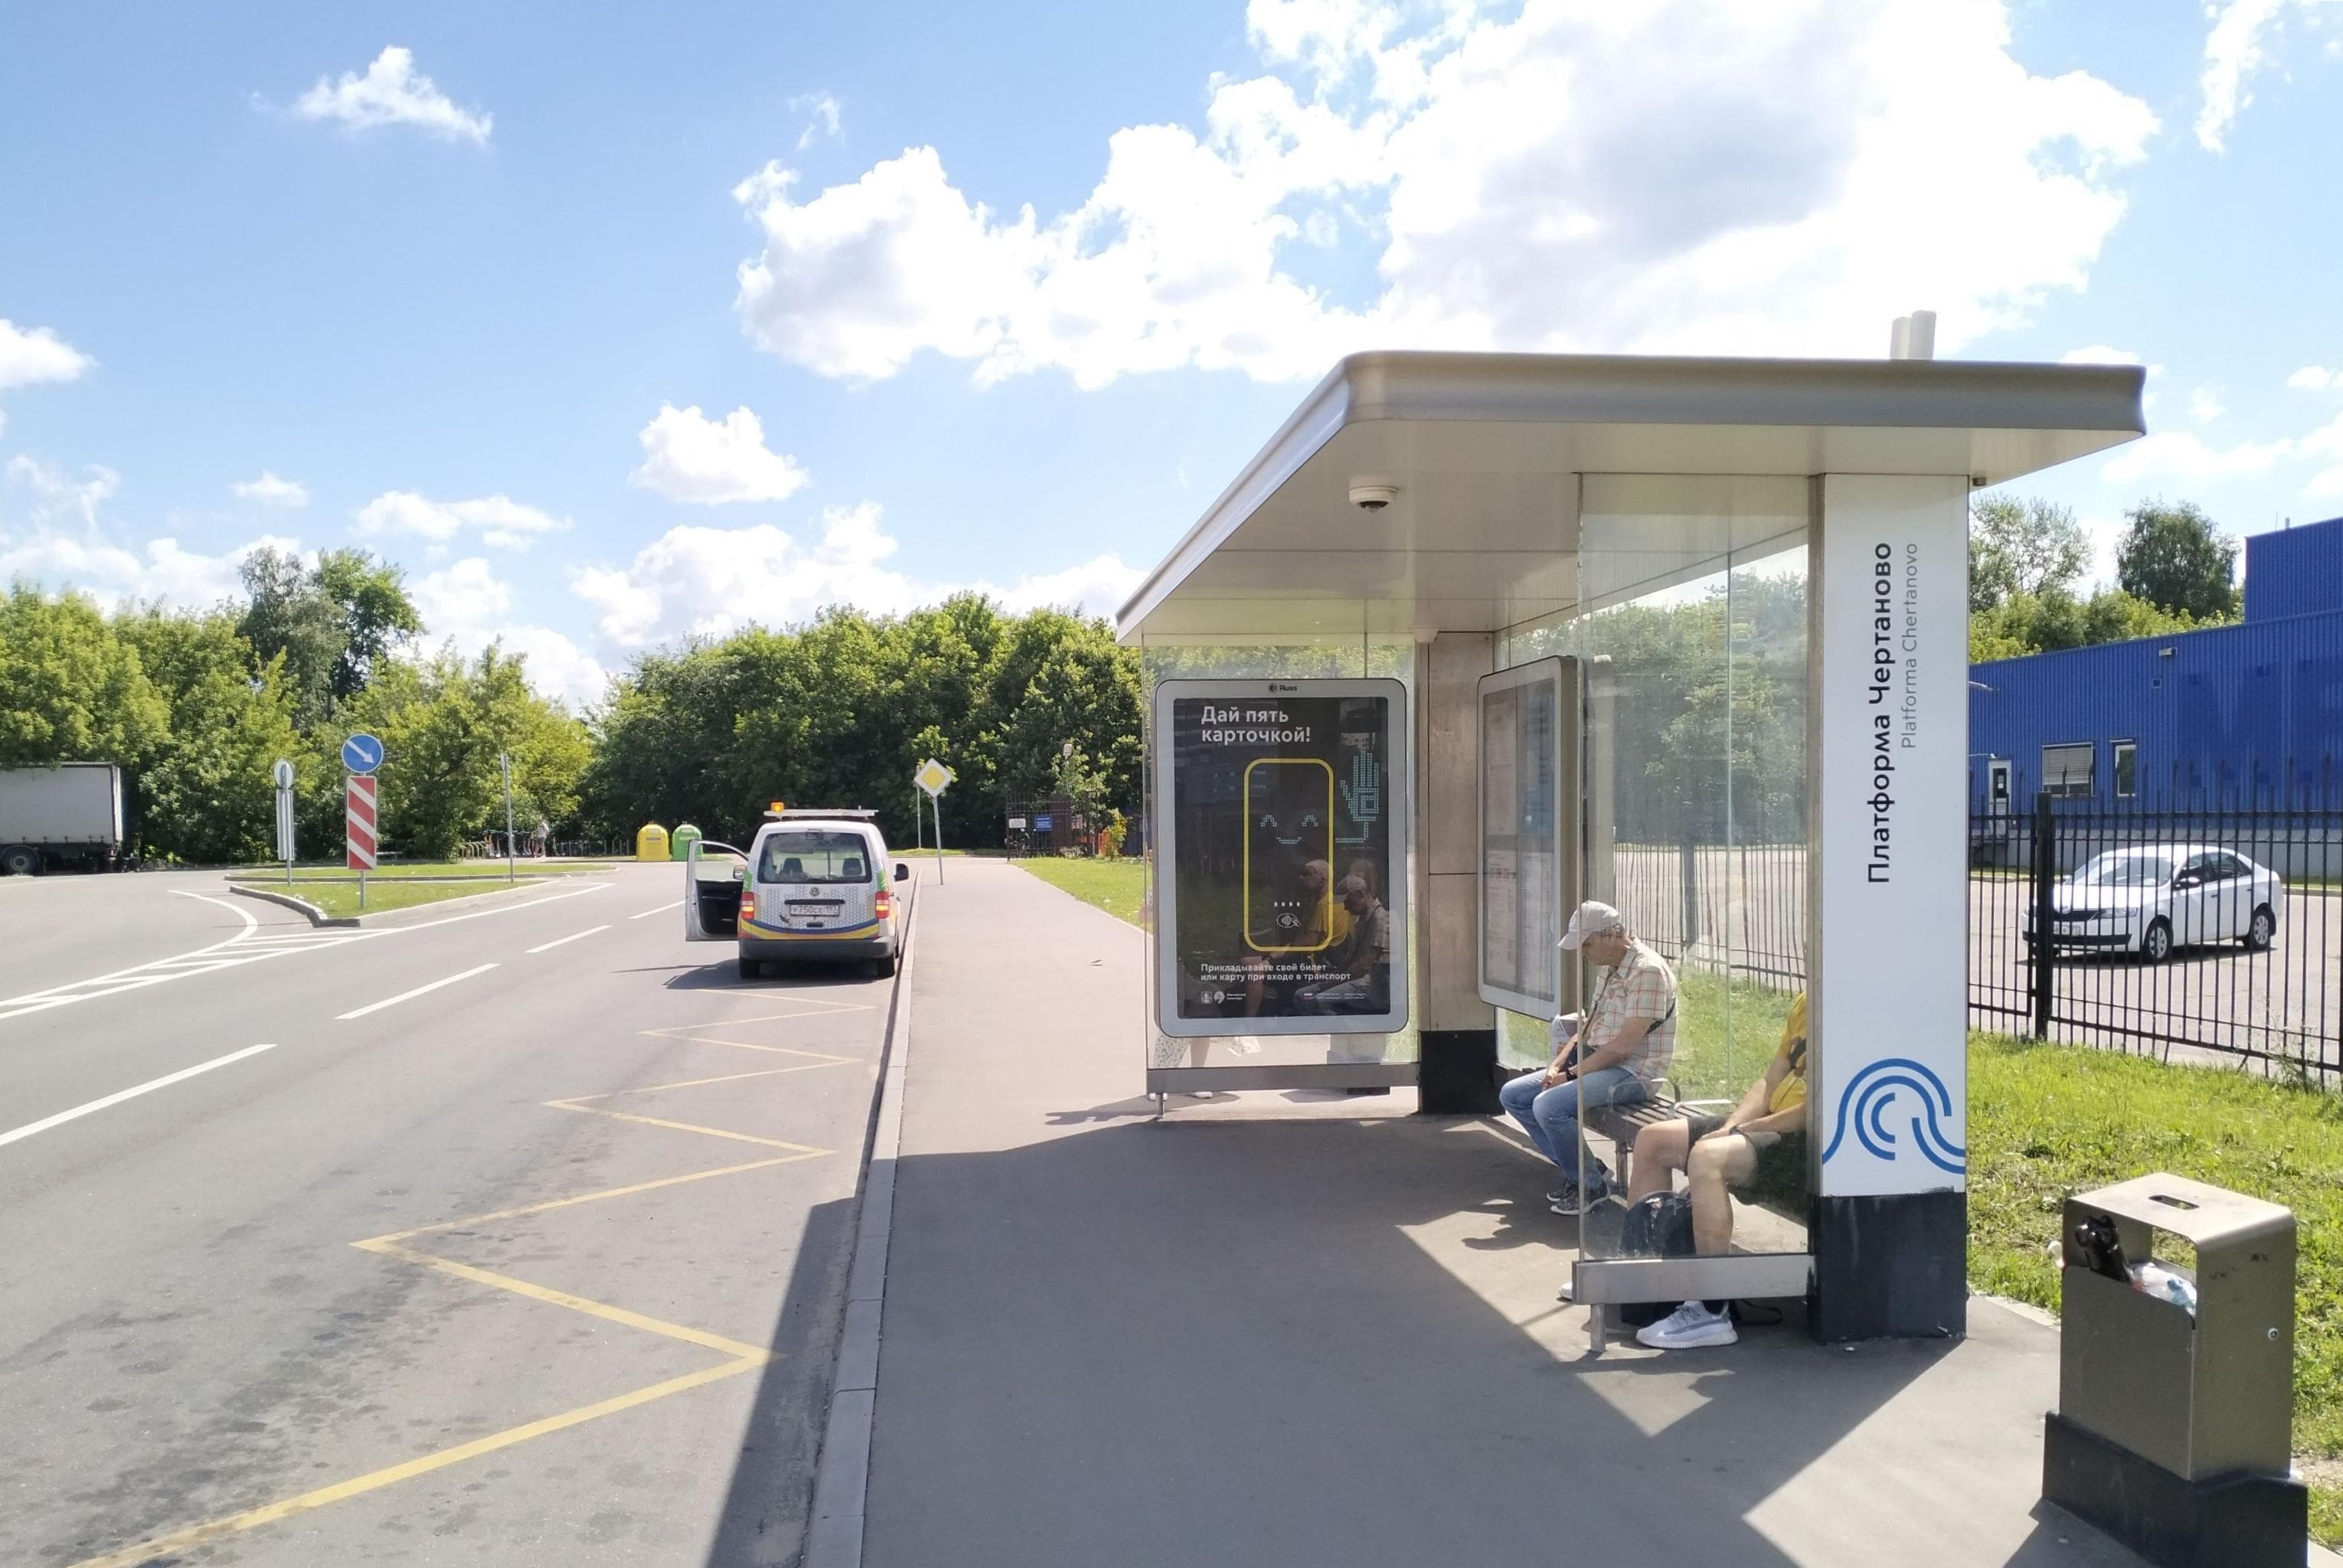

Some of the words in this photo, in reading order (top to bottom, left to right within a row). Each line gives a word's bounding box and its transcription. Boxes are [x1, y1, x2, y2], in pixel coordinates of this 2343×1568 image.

[1868, 542, 1896, 704] Чертаново
[1901, 543, 1918, 652] Chertanovo
[1201, 705, 1240, 725] Дай
[1246, 710, 1289, 723] пять
[1900, 658, 1917, 749] Platforma
[1201, 726, 1311, 746] карточкой!
[1867, 714, 1896, 883] Платформа
[1201, 963, 1274, 973] Прикладывайте
[1276, 963, 1298, 972] свой
[1299, 962, 1327, 972] билет
[1220, 974, 1246, 983] карту
[1247, 974, 1265, 983] при
[1304, 973, 1351, 983] транспорт
